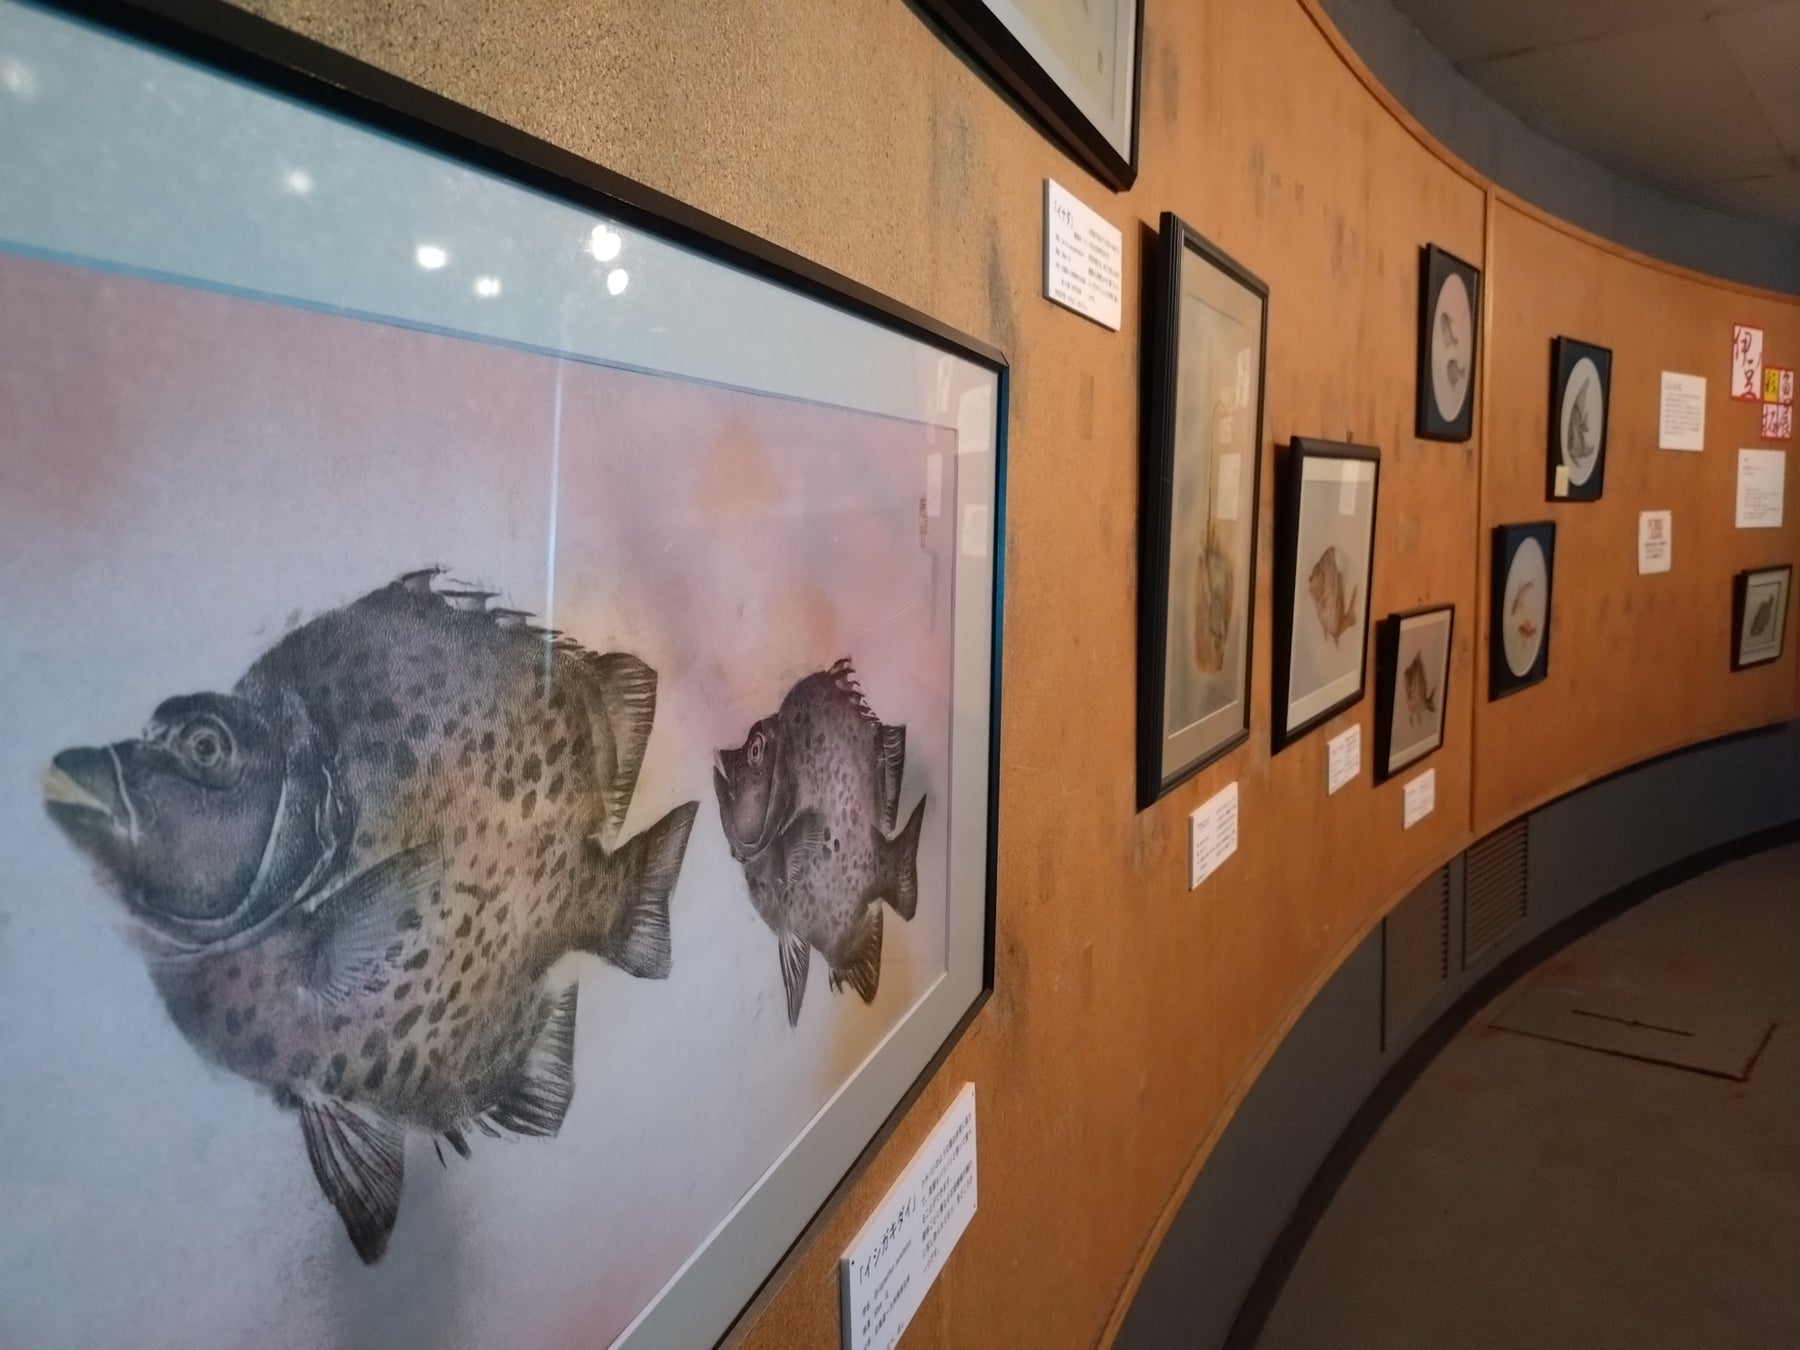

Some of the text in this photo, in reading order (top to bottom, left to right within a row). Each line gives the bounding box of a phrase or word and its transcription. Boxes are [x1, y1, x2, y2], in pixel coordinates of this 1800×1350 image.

[859, 1194, 916, 1286] 「イシガキダイ」
